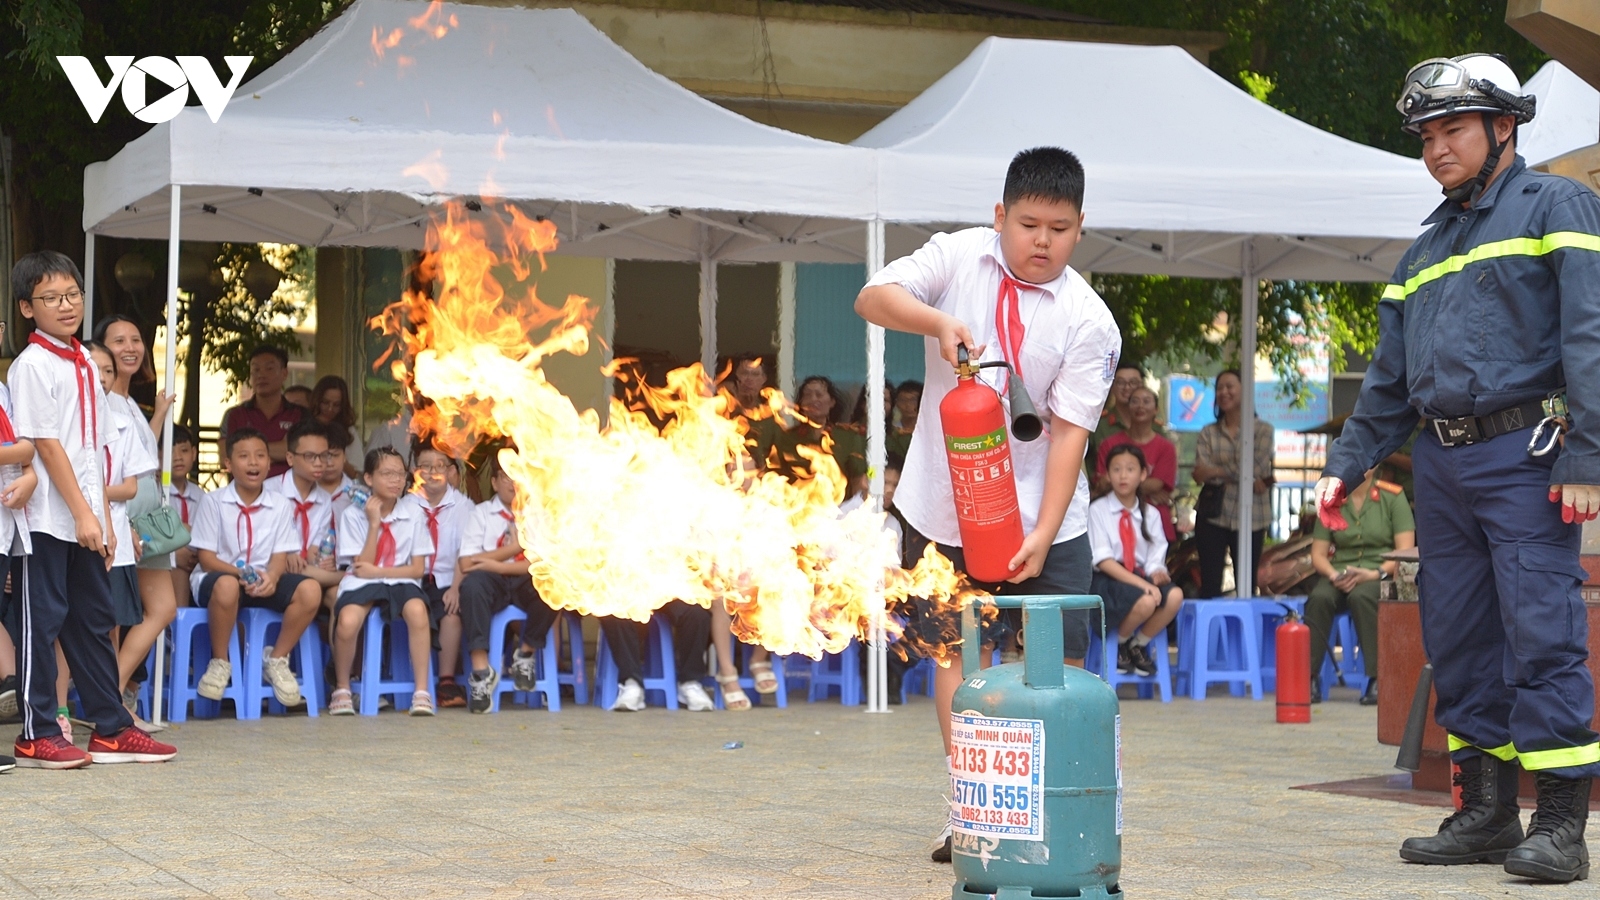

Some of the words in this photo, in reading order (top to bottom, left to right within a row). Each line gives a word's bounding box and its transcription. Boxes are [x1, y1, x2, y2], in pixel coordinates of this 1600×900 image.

[975, 729, 1000, 742] MINH
[1002, 729, 1032, 744] QUÂN
[993, 749, 1030, 777] 433
[993, 783, 1029, 811] 555
[961, 806, 1003, 825] 0962.133
[1007, 811, 1029, 826] 433
